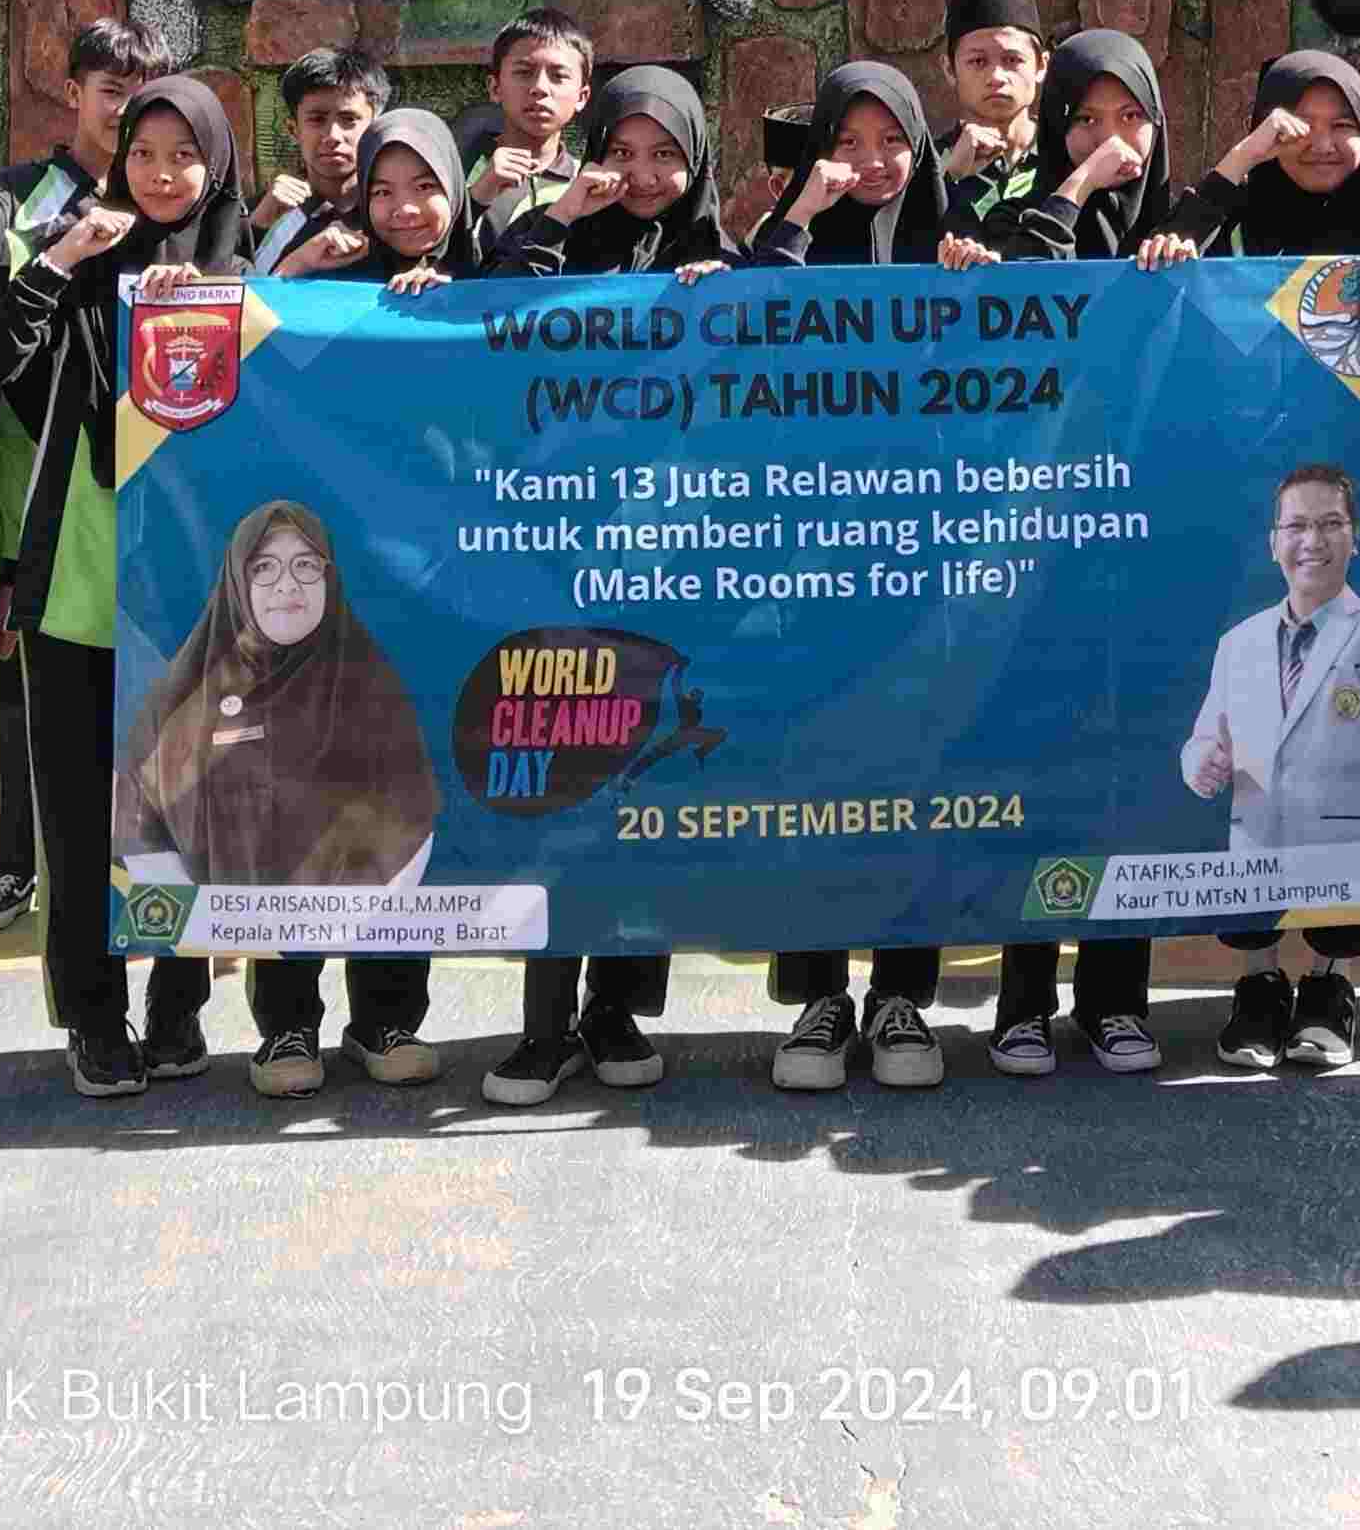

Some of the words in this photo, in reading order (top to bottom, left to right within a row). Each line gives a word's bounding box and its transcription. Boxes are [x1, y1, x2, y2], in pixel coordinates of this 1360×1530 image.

[199, 289, 237, 300] BARAT
[481, 306, 686, 352] WORLD
[699, 297, 874, 348] CLEAN
[890, 295, 963, 343] UP
[977, 293, 1091, 342] DAY
[526, 373, 695, 434] (WCD)
[710, 371, 901, 419] TAHUN
[919, 367, 1065, 415] 2024
[475, 466, 597, 502] "Kami
[611, 466, 657, 501] 13
[663, 466, 751, 508] Juta
[765, 461, 943, 498] Relawan
[956, 454, 1131, 494] bebersih
[458, 516, 584, 552] untuk
[596, 514, 782, 551] memberi
[797, 516, 920, 556] ruang
[932, 506, 1150, 549] kehidupan
[573, 567, 702, 608] (Make
[715, 566, 856, 600] Rooms
[868, 562, 929, 597] for
[942, 558, 1036, 599] life)"
[499, 646, 617, 696] WORLD
[492, 698, 642, 747] CLEANUP
[486, 750, 555, 799] DAY
[617, 806, 665, 840] 20
[677, 798, 917, 839] SEPTEMBER
[929, 794, 1026, 831] 2024
[210, 895, 252, 912] DESI
[1115, 892, 1160, 910] Kaur
[1165, 890, 1190, 908] TU
[1196, 886, 1248, 905] MTsN
[1254, 886, 1262, 903] 1
[1268, 880, 1352, 903] Lampung
[211, 925, 273, 943] Kepala
[279, 925, 333, 942] MTsN
[339, 925, 347, 941] 1
[355, 925, 445, 945] Lampung
[456, 925, 508, 941] Barat
